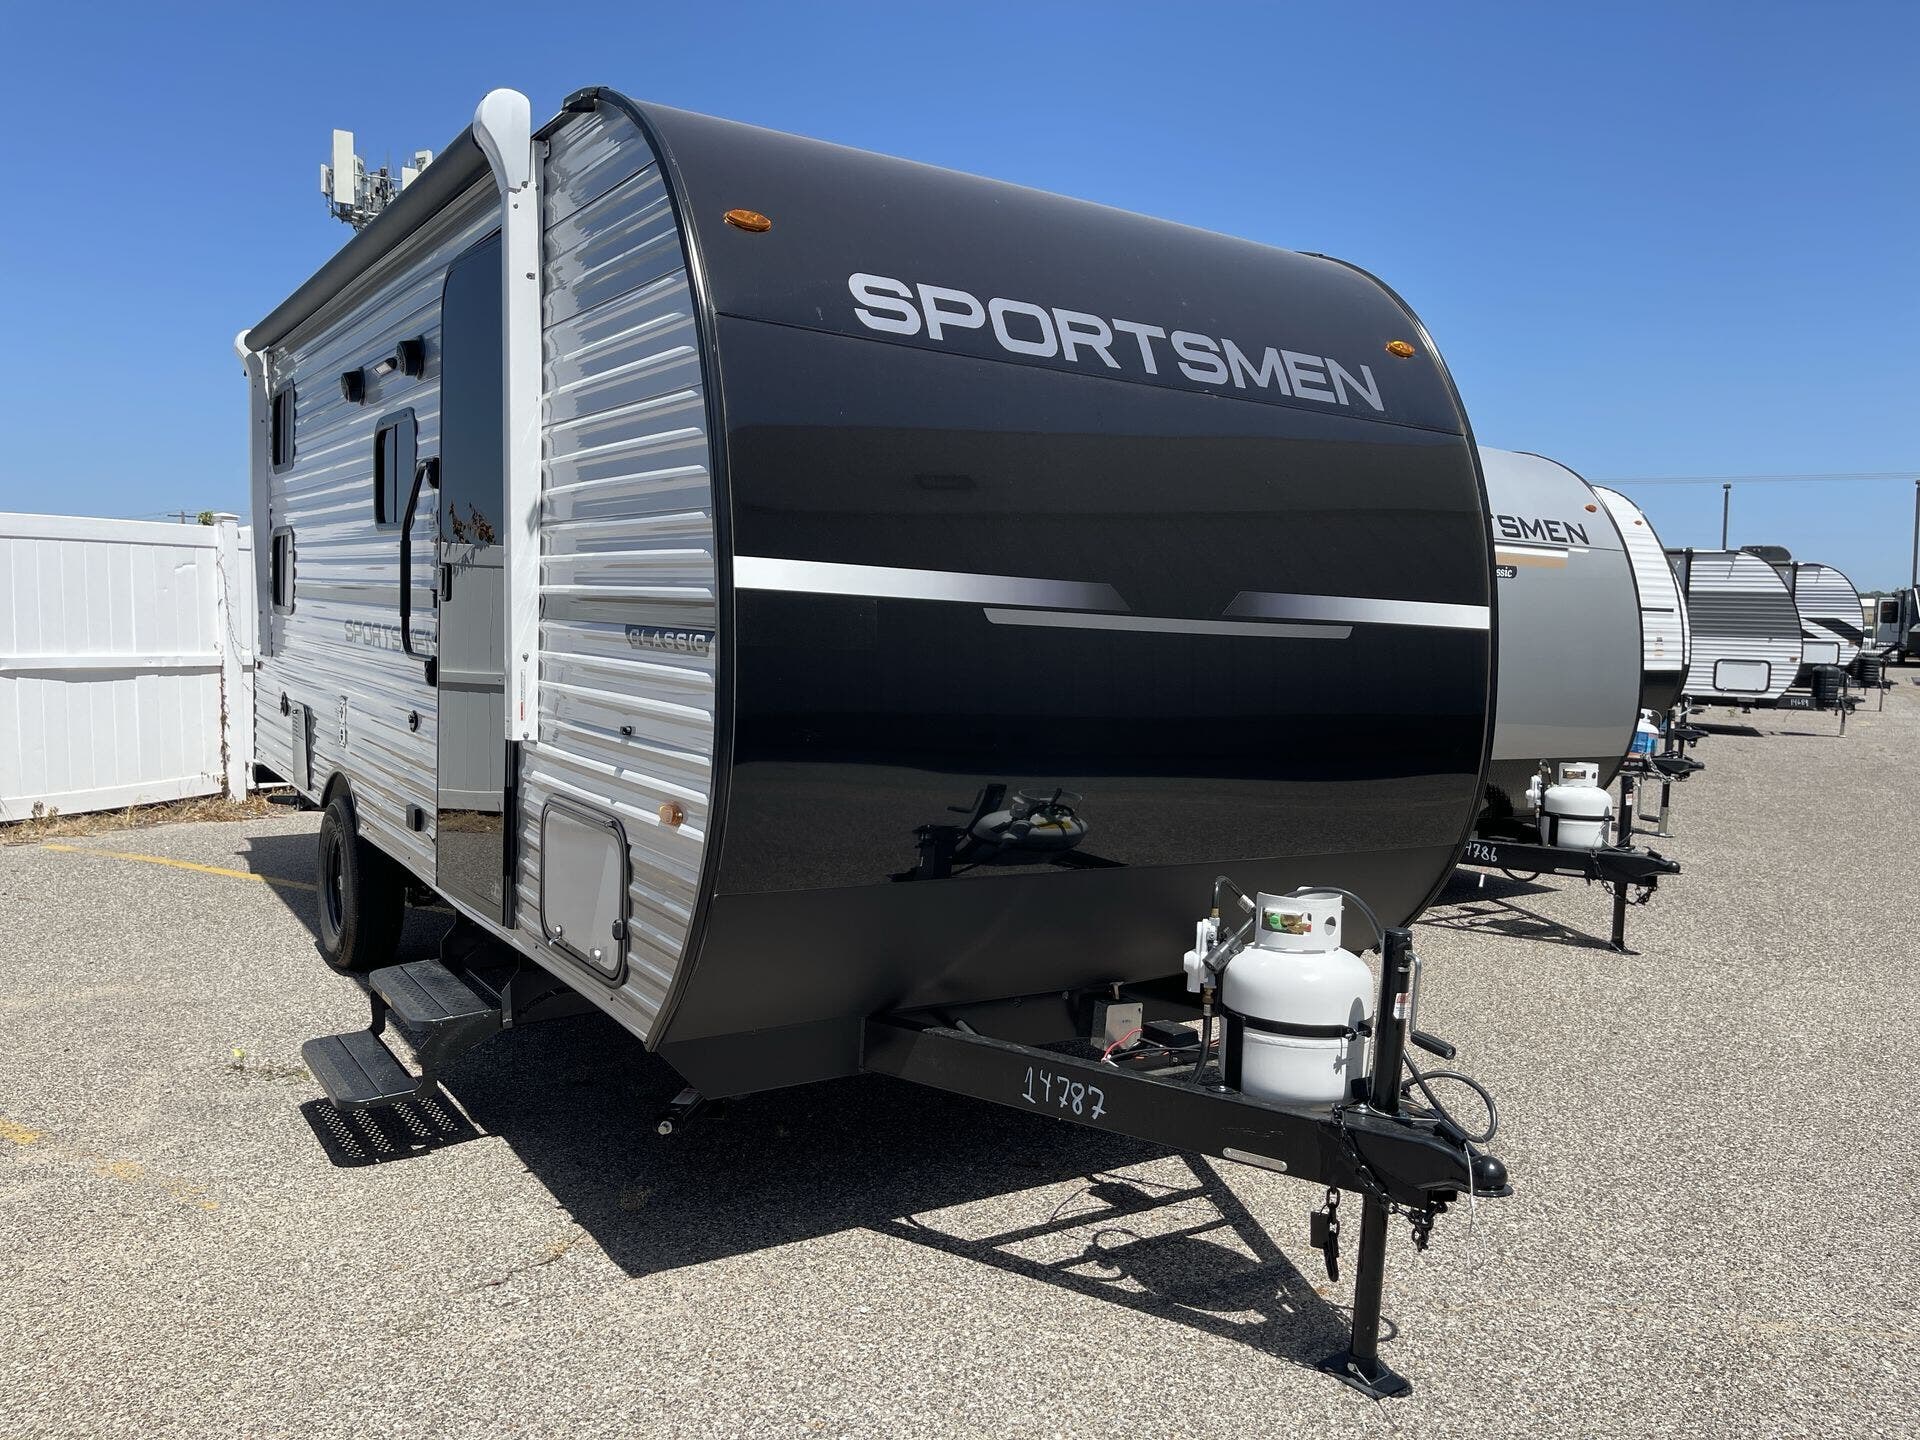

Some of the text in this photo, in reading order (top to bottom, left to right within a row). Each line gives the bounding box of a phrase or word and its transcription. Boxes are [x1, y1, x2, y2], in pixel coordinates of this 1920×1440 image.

[848, 272, 1385, 411] SPORTSMEN
[1490, 513, 1590, 545] SMEN
[629, 628, 706, 653] CLASSIC
[1022, 1066, 1107, 1120] 14787
